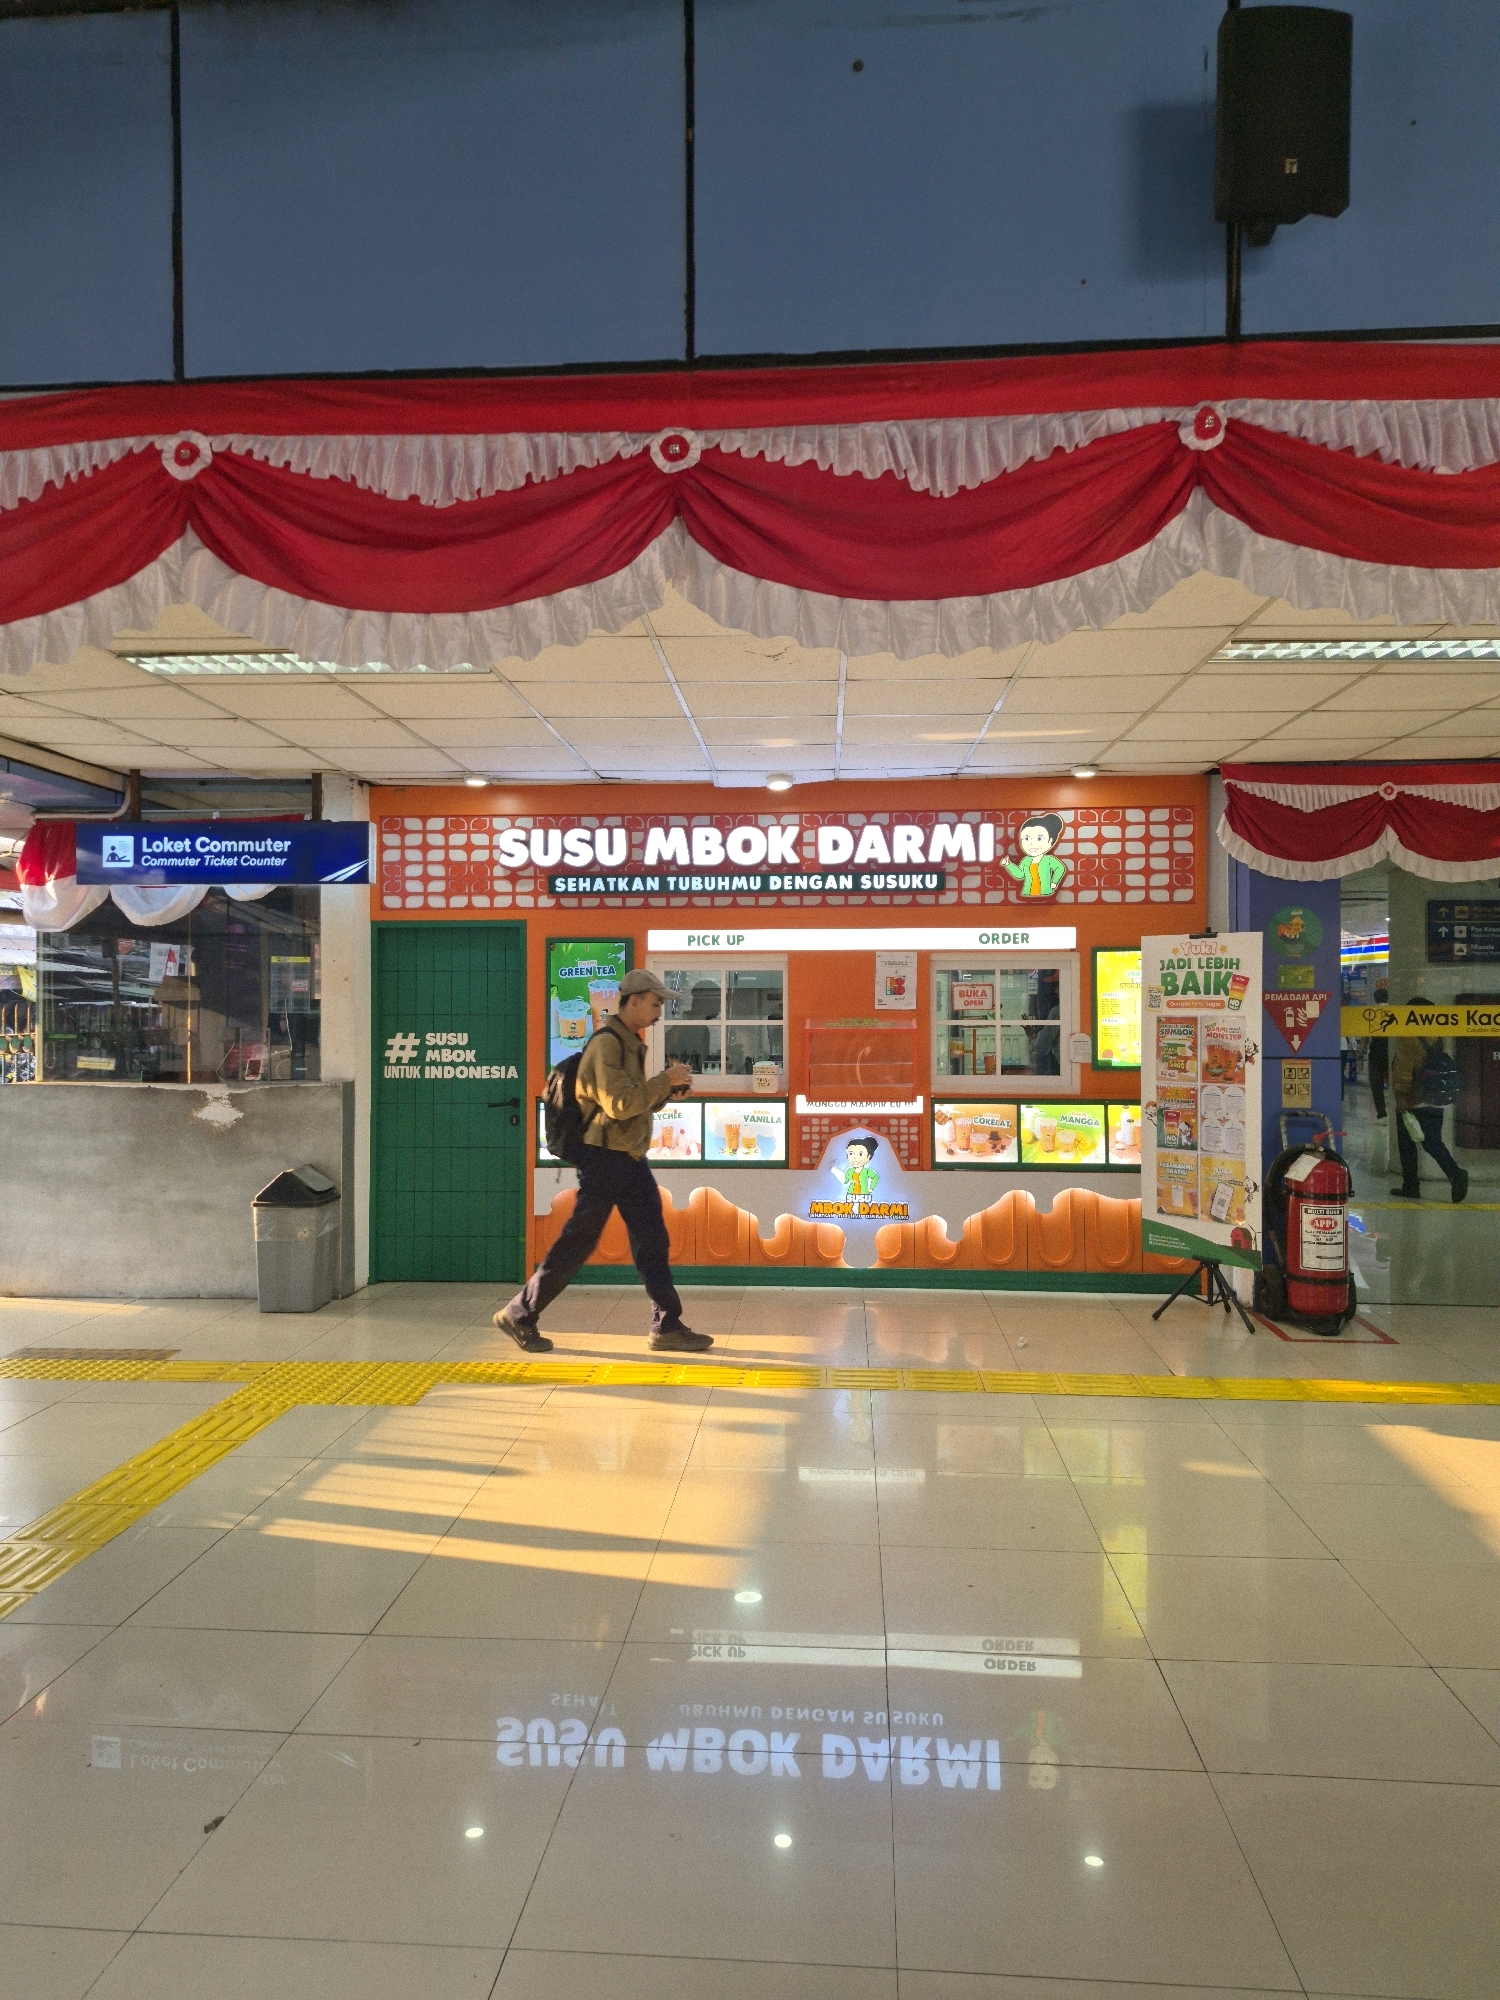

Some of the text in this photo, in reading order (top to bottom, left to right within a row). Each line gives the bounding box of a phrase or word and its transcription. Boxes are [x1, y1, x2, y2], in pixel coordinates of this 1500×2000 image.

[142, 836, 292, 853] Loket Commuter
[499, 823, 995, 868] SUSU MBOK DARMI
[141, 854, 287, 866] Commuter Ticket Counter
[555, 873, 938, 893] SEHATKAN TUBUHMU DENGAN SUSUKU
[687, 934, 745, 946] PICK UP
[978, 932, 1030, 945] ORDER
[1180, 940, 1217, 956] Yuk!
[559, 965, 616, 977] GREEN TEA
[1160, 957, 1241, 972] JADI LEBIH
[1161, 970, 1233, 997] BAIK
[958, 989, 988, 998] BUKA
[1265, 993, 1327, 1001] PEMADAM API
[1405, 1010, 1459, 1026] Awas
[384, 1032, 469, 1064] # SUSU
[425, 1049, 477, 1062] MBOK
[383, 1065, 519, 1079] UNTUK INDONESIA
[652, 1112, 683, 1121] LYCHEE
[743, 1114, 782, 1124] VANILLA
[973, 1116, 1011, 1128] COKELAT
[1060, 1115, 1100, 1127] MANGGA
[847, 1194, 872, 1202] SUSU
[810, 1201, 853, 1214] MBOK
[859, 1202, 909, 1216] DARMI
[1313, 1219, 1336, 1228] APPI
